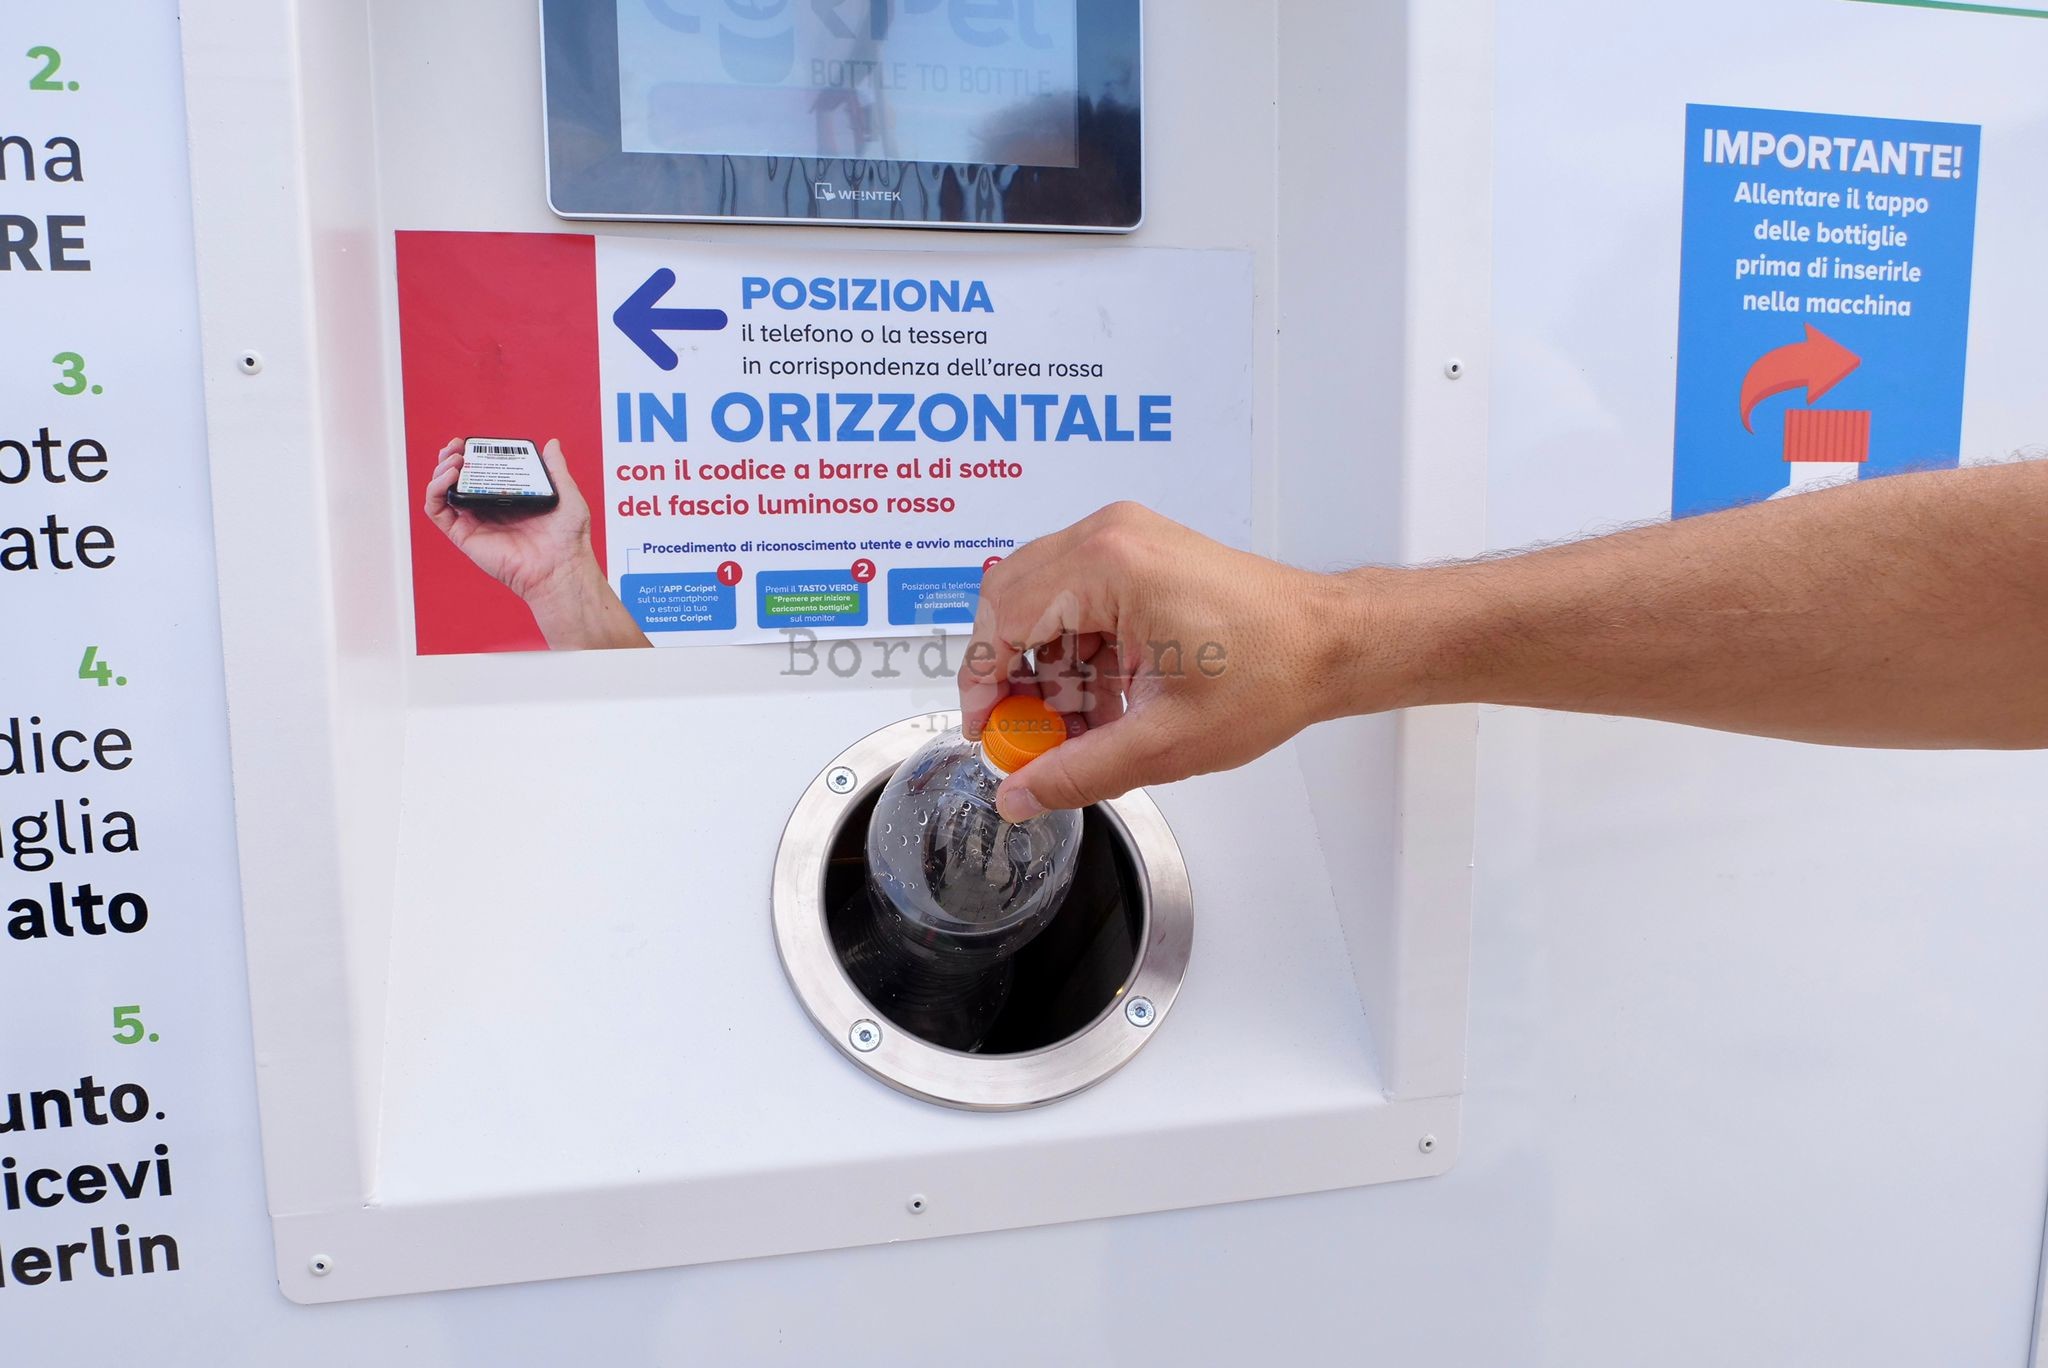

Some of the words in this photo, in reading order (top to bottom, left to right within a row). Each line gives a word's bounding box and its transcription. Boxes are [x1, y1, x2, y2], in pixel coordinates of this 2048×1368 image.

[26, 45, 80, 91] 2.
[811, 58, 907, 91] BOTTLE
[917, 63, 949, 92] TO
[959, 65, 1052, 96] BOTTLE
[1703, 128, 1963, 179] IMPORTANTE!
[1734, 182, 1840, 208] Allentare
[1846, 187, 1860, 210] il
[1865, 190, 1929, 218] tappo
[0, 215, 91, 272] RE
[1754, 219, 1810, 243] delle
[1817, 220, 1908, 251] bottiglie
[1735, 254, 1800, 281] prima
[1807, 256, 1828, 279] di
[1834, 257, 1921, 283] inserirle
[741, 276, 994, 313] POSIZIONA
[1743, 291, 1800, 313] nella
[1806, 294, 1911, 317] macchina
[741, 324, 755, 343] il
[760, 324, 854, 345] telefono
[861, 329, 875, 345] o
[881, 325, 901, 345] la
[908, 326, 988, 346] tessera
[52, 351, 103, 396] 3.
[743, 356, 761, 376] in
[768, 356, 940, 380] corrispondenza
[947, 358, 1041, 378] dell'area
[1048, 362, 1103, 378] rossa
[616, 392, 688, 443] IN
[710, 392, 1172, 443] ORIZZONTALE
[616, 463, 666, 482] con
[674, 459, 691, 481] il
[699, 459, 786, 481] codice
[793, 463, 811, 480] a
[819, 459, 888, 480] barre
[896, 458, 921, 480] al
[928, 457, 952, 479] di
[959, 459, 1023, 479] sotto
[617, 494, 661, 517] del
[668, 494, 750, 516] fascio
[758, 493, 880, 515] luminoso
[886, 496, 956, 514] rosso
[0, 514, 116, 572] ate
[642, 541, 736, 554] Procedimento
[740, 540, 753, 553] di
[756, 540, 857, 552] riconoscimento
[860, 540, 901, 551] utente
[905, 541, 913, 550] e
[916, 540, 951, 550] avvio
[954, 537, 1014, 549] macchina
[724, 565, 733, 580] 1
[857, 562, 869, 578] 2
[637, 595, 650, 604] sul
[652, 596, 666, 604] tuo
[668, 594, 719, 604] smartphone
[639, 586, 657, 595] Apri
[684, 584, 717, 594] Coripet
[765, 585, 789, 593] Premi
[791, 584, 796, 592] il
[798, 584, 827, 592] TASTO
[828, 583, 859, 592] VERDE
[810, 595, 822, 603] per
[902, 582, 940, 591] Posiziona
[941, 582, 947, 590] il
[926, 592, 934, 600] la
[935, 591, 965, 600] tessera
[657, 605, 681, 613] estrai
[683, 604, 692, 612] la
[693, 604, 707, 612] tua
[772, 604, 817, 613] caricamento
[914, 601, 922, 609] in
[924, 600, 970, 609] orizzontale
[645, 615, 678, 623] tessera
[680, 614, 713, 624] Coripet
[790, 615, 803, 623] sul
[804, 614, 836, 622] monitor
[78, 646, 128, 686] 4.
[0, 797, 139, 872] glia
[7, 881, 148, 941] alto
[112, 1005, 160, 1045] 5.
[1, 1143, 173, 1210] icevi
[0, 1223, 180, 1287] erlin
